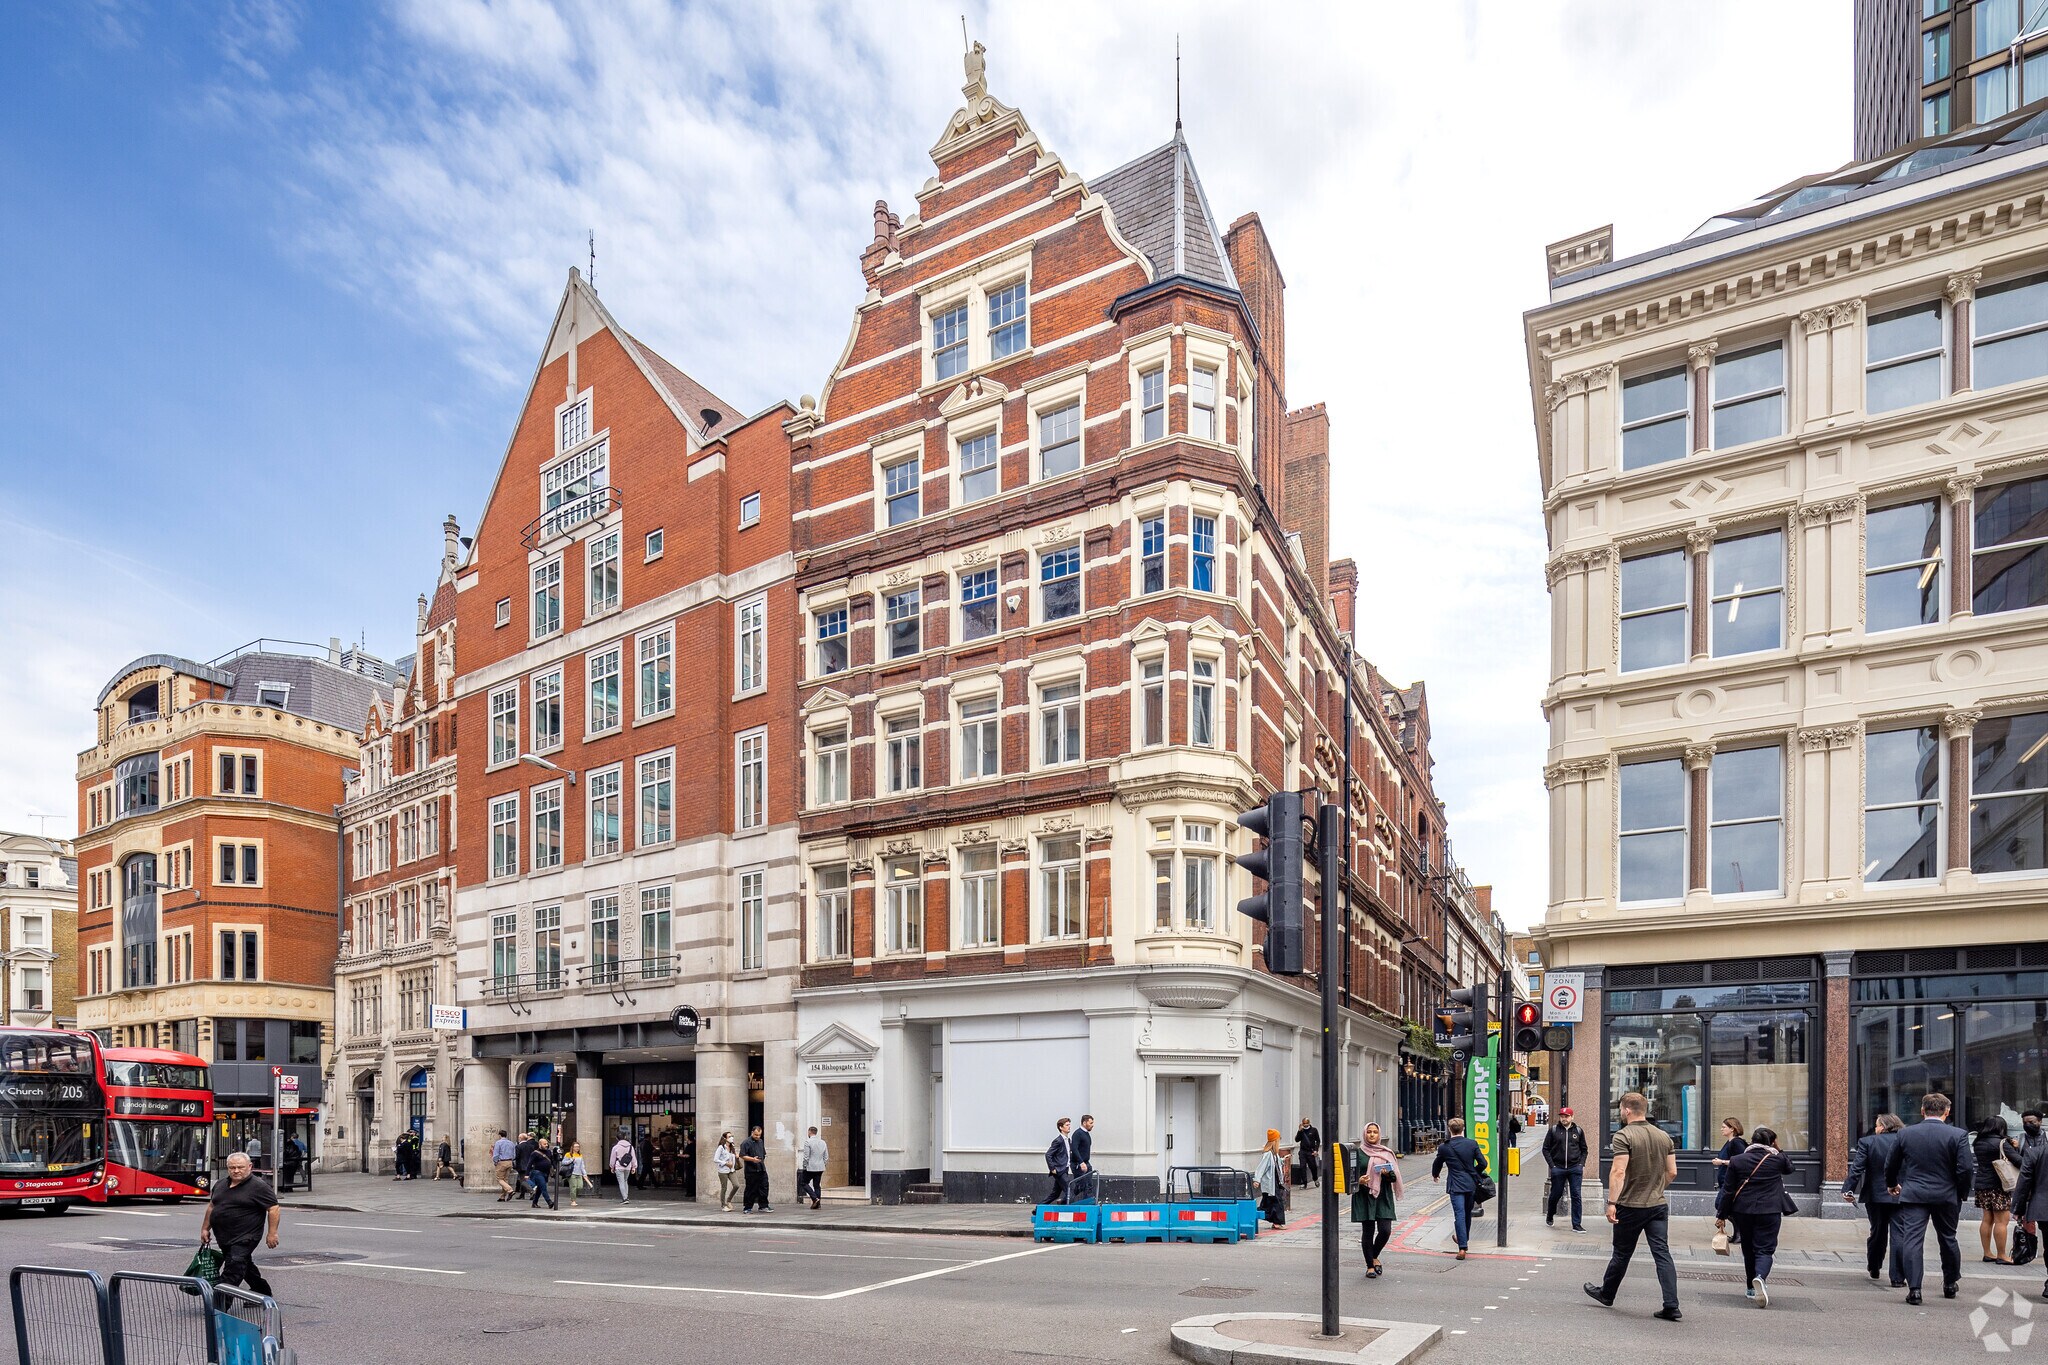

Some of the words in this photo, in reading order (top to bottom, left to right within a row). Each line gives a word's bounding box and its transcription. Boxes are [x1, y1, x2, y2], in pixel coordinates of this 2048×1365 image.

[821, 1063, 853, 1071] Bishopsgate
[854, 1062, 866, 1070] EC2
[7, 1087, 43, 1095] Church
[61, 1086, 83, 1098] 205
[148, 1102, 169, 1110] Bridge
[181, 1102, 196, 1113] 149
